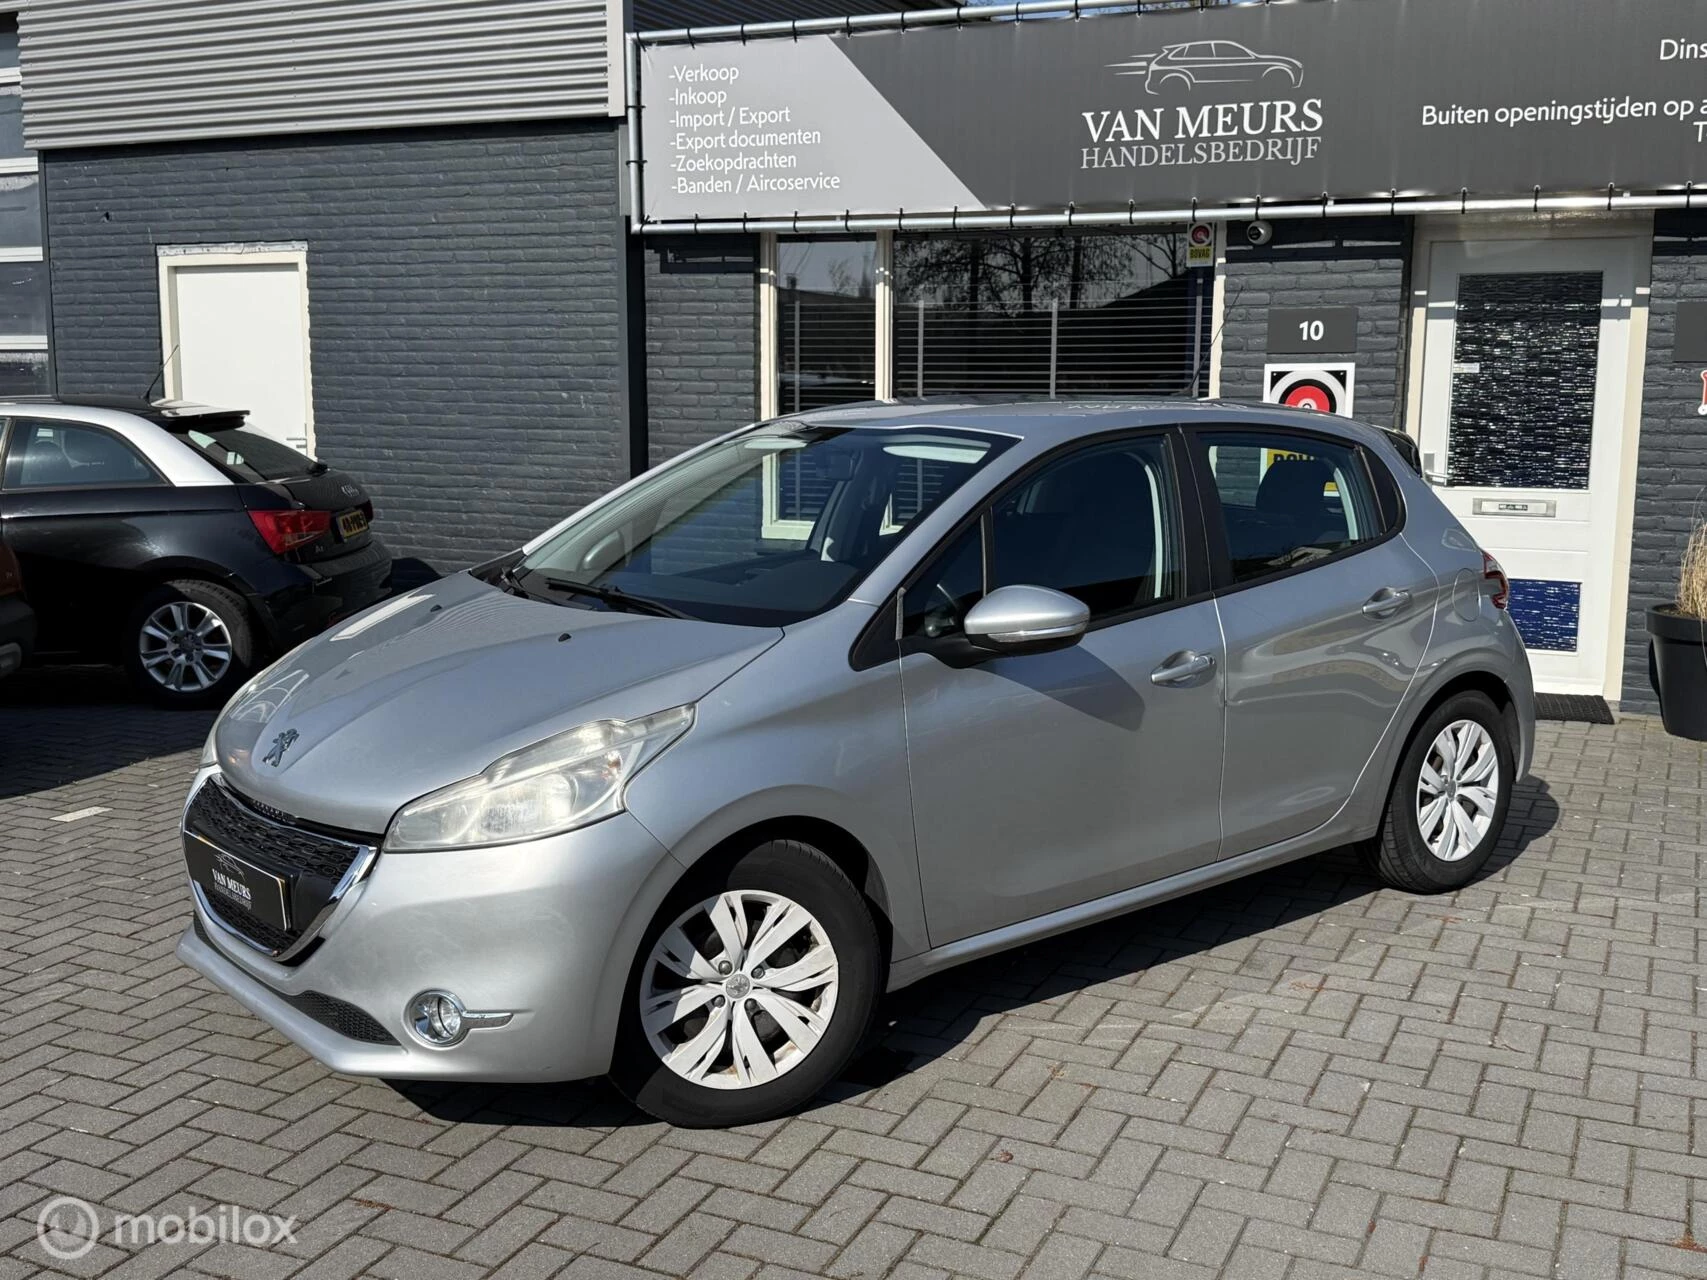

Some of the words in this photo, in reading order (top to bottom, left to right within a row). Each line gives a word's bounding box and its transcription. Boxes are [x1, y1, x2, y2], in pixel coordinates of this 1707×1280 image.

[1659, 38, 1707, 60] Dins
[668, 64, 740, 84] -Verkoop
[668, 86, 727, 107] -Inkoop
[669, 110, 725, 131] -Import
[739, 106, 791, 128] Export
[1081, 108, 1164, 143] VAN
[1174, 98, 1323, 139] MEURS
[1422, 104, 1489, 125] Buiten
[1494, 96, 1657, 128] openingstijden
[1663, 100, 1694, 121] op
[669, 132, 726, 153] -Export
[728, 128, 821, 148] documenten
[1693, 121, 1707, 143] T
[669, 151, 797, 174] -Zoekopdrachten
[1080, 136, 1322, 169] HANDELSBEDRIJF
[671, 175, 732, 194] -Banden
[746, 172, 841, 192] Aircoservice
[1299, 320, 1324, 341] 10
[212, 868, 227, 887] VAN
